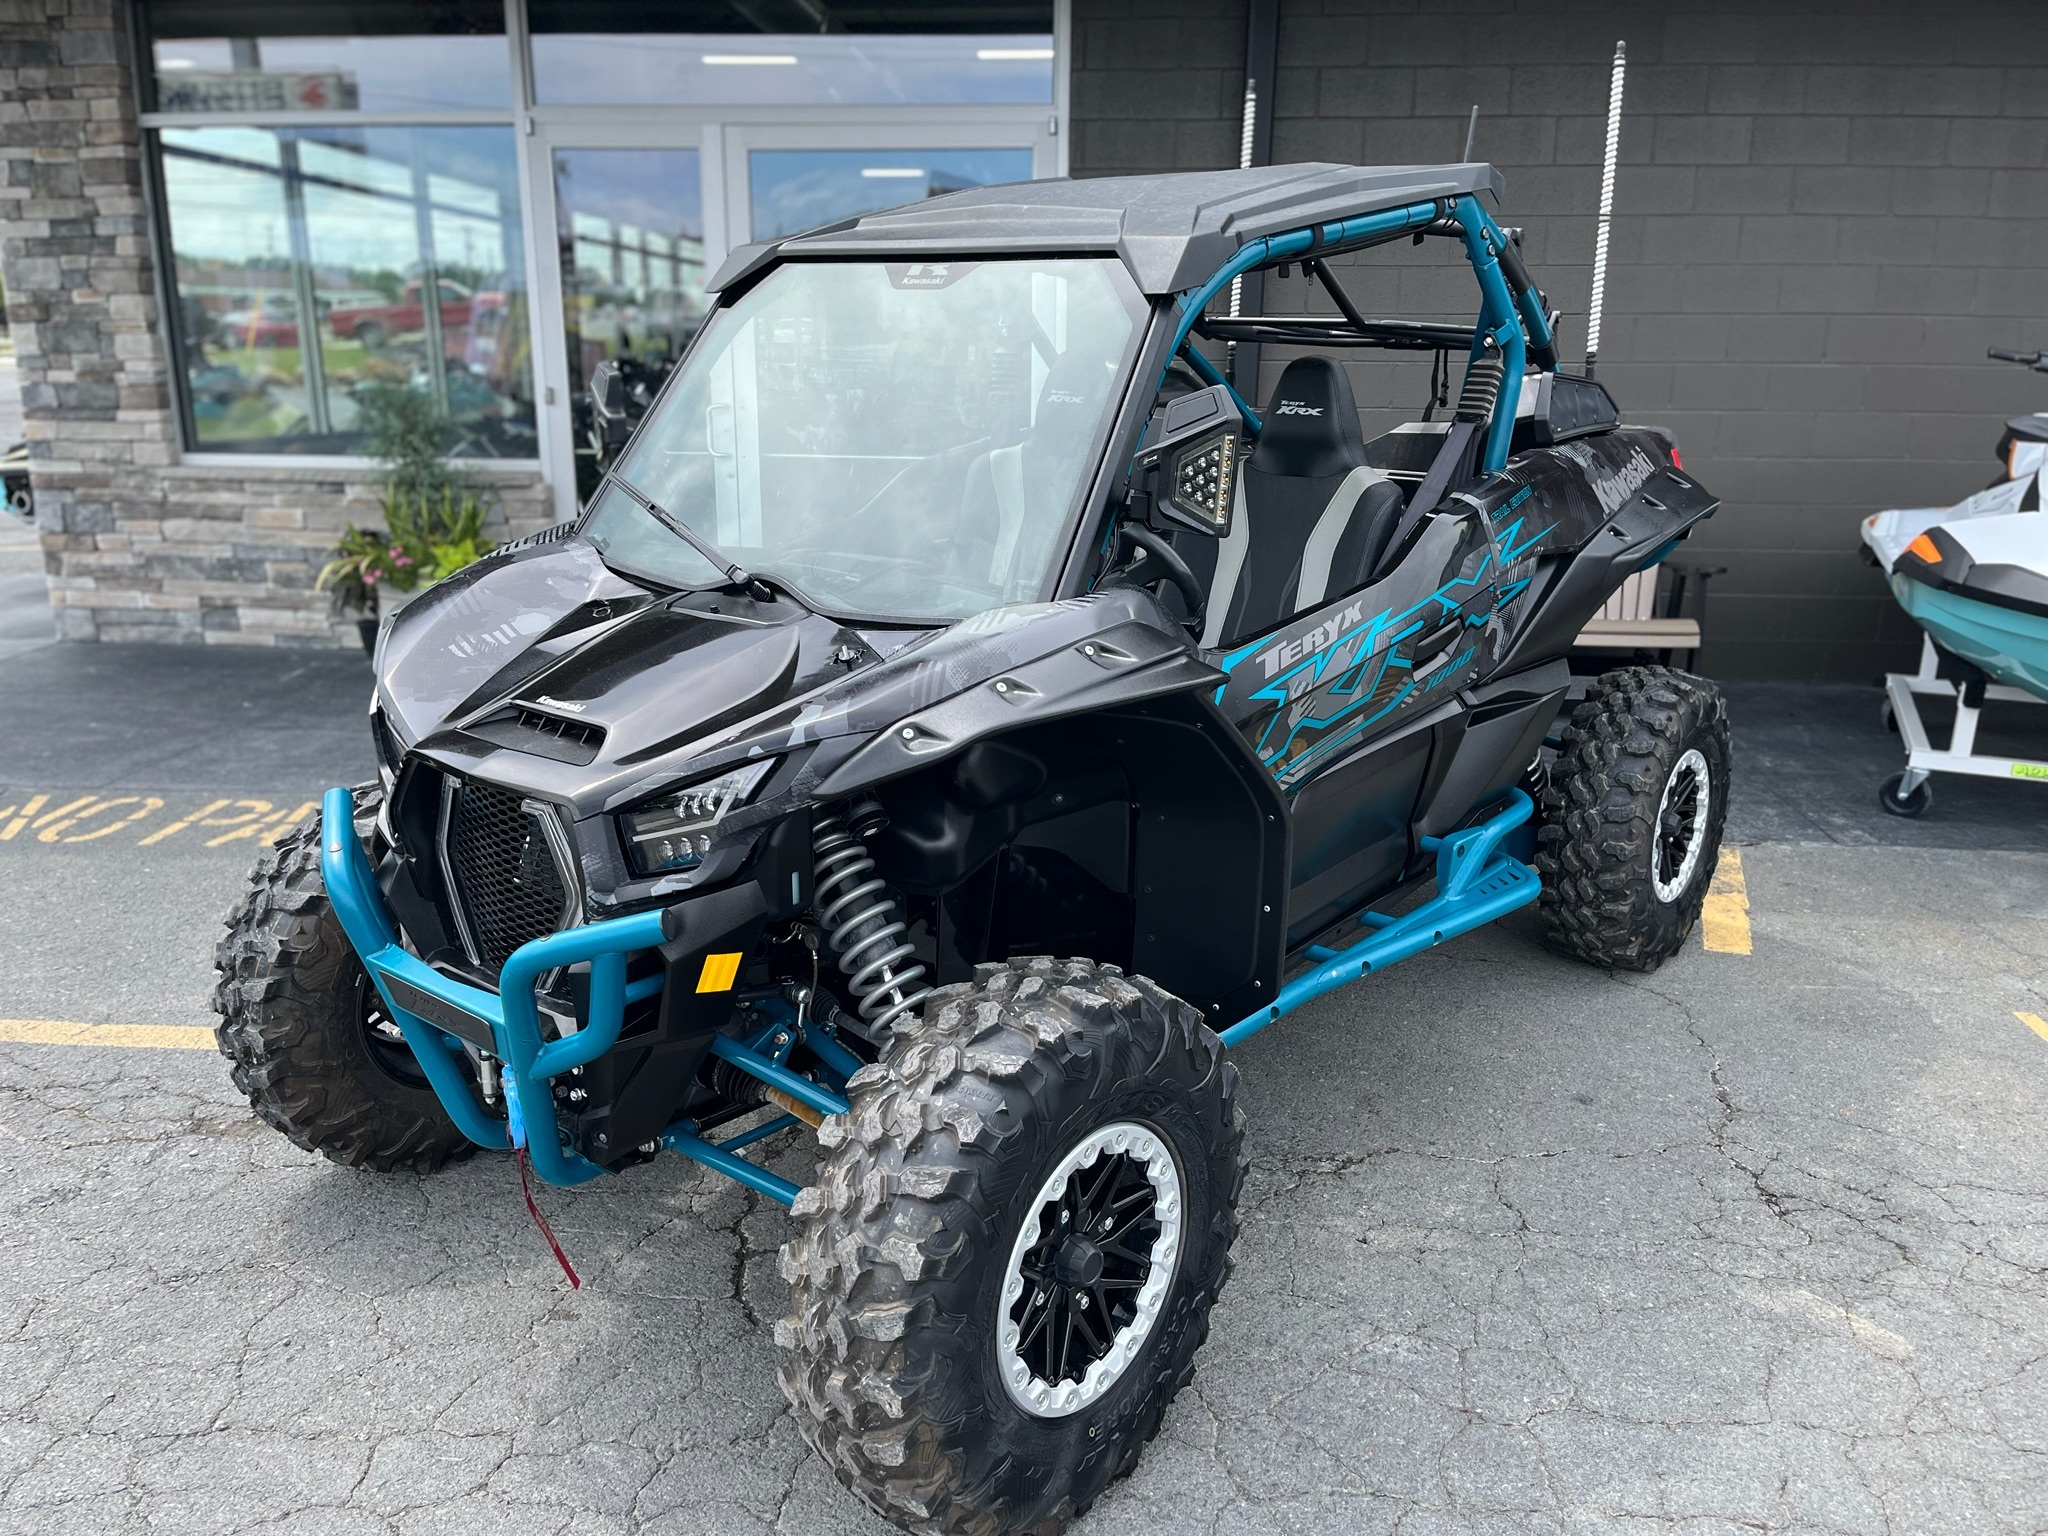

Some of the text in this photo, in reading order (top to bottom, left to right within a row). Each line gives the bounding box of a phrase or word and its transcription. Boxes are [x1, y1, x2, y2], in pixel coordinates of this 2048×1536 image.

[902, 276, 945, 285] Kawasaki
[1275, 405, 1324, 416] KRX
[1592, 446, 1656, 514] Kawasaki
[1255, 600, 1364, 680] TERYX
[1424, 645, 1477, 693] 1000
[536, 695, 587, 713] Kawasaki
